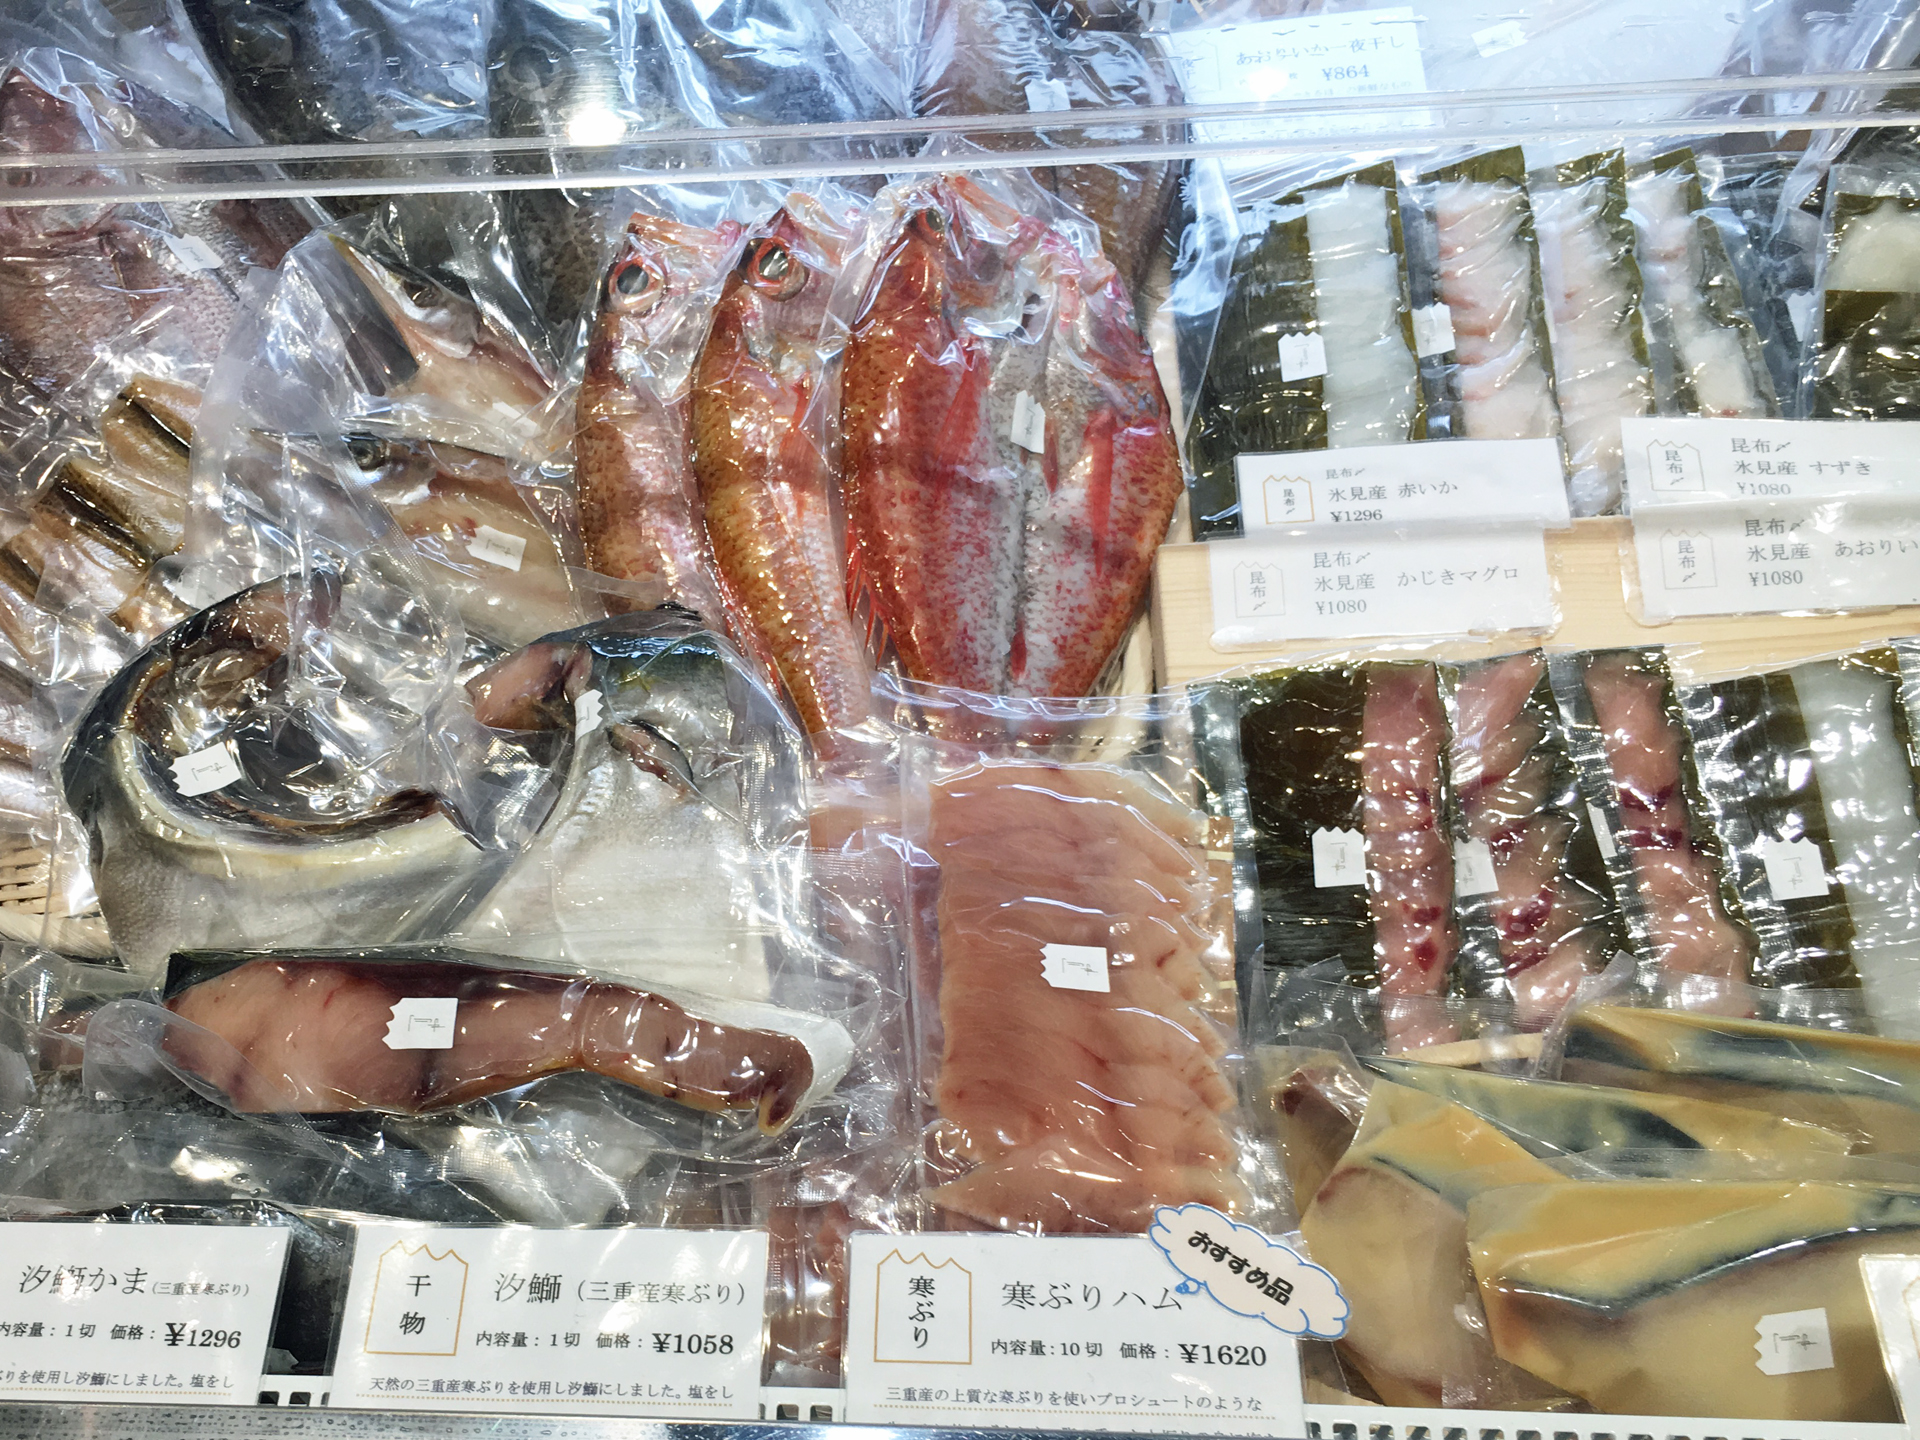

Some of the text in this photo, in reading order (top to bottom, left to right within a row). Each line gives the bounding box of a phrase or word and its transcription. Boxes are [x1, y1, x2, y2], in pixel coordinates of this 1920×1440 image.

[1322, 64, 1370, 81] ¥864
[1734, 459, 1871, 476] 氷見産 すずき
[1328, 480, 1459, 503] 氷見産 赤いか
[1737, 482, 1792, 496] ¥1080
[1330, 508, 1383, 523] ¥1296
[1746, 540, 1919, 563] 氷見産 あおりい
[1314, 566, 1519, 592] 氷見産 かじきマグロ
[1749, 570, 1803, 587] ¥1080
[1316, 599, 1368, 616] ¥1080
[1187, 1228, 1296, 1308] おすすめ品
[399, 1274, 432, 1336] 干物
[1000, 1280, 1184, 1312] 寒ぶりハム
[907, 1274, 936, 1349] 寒ぶり
